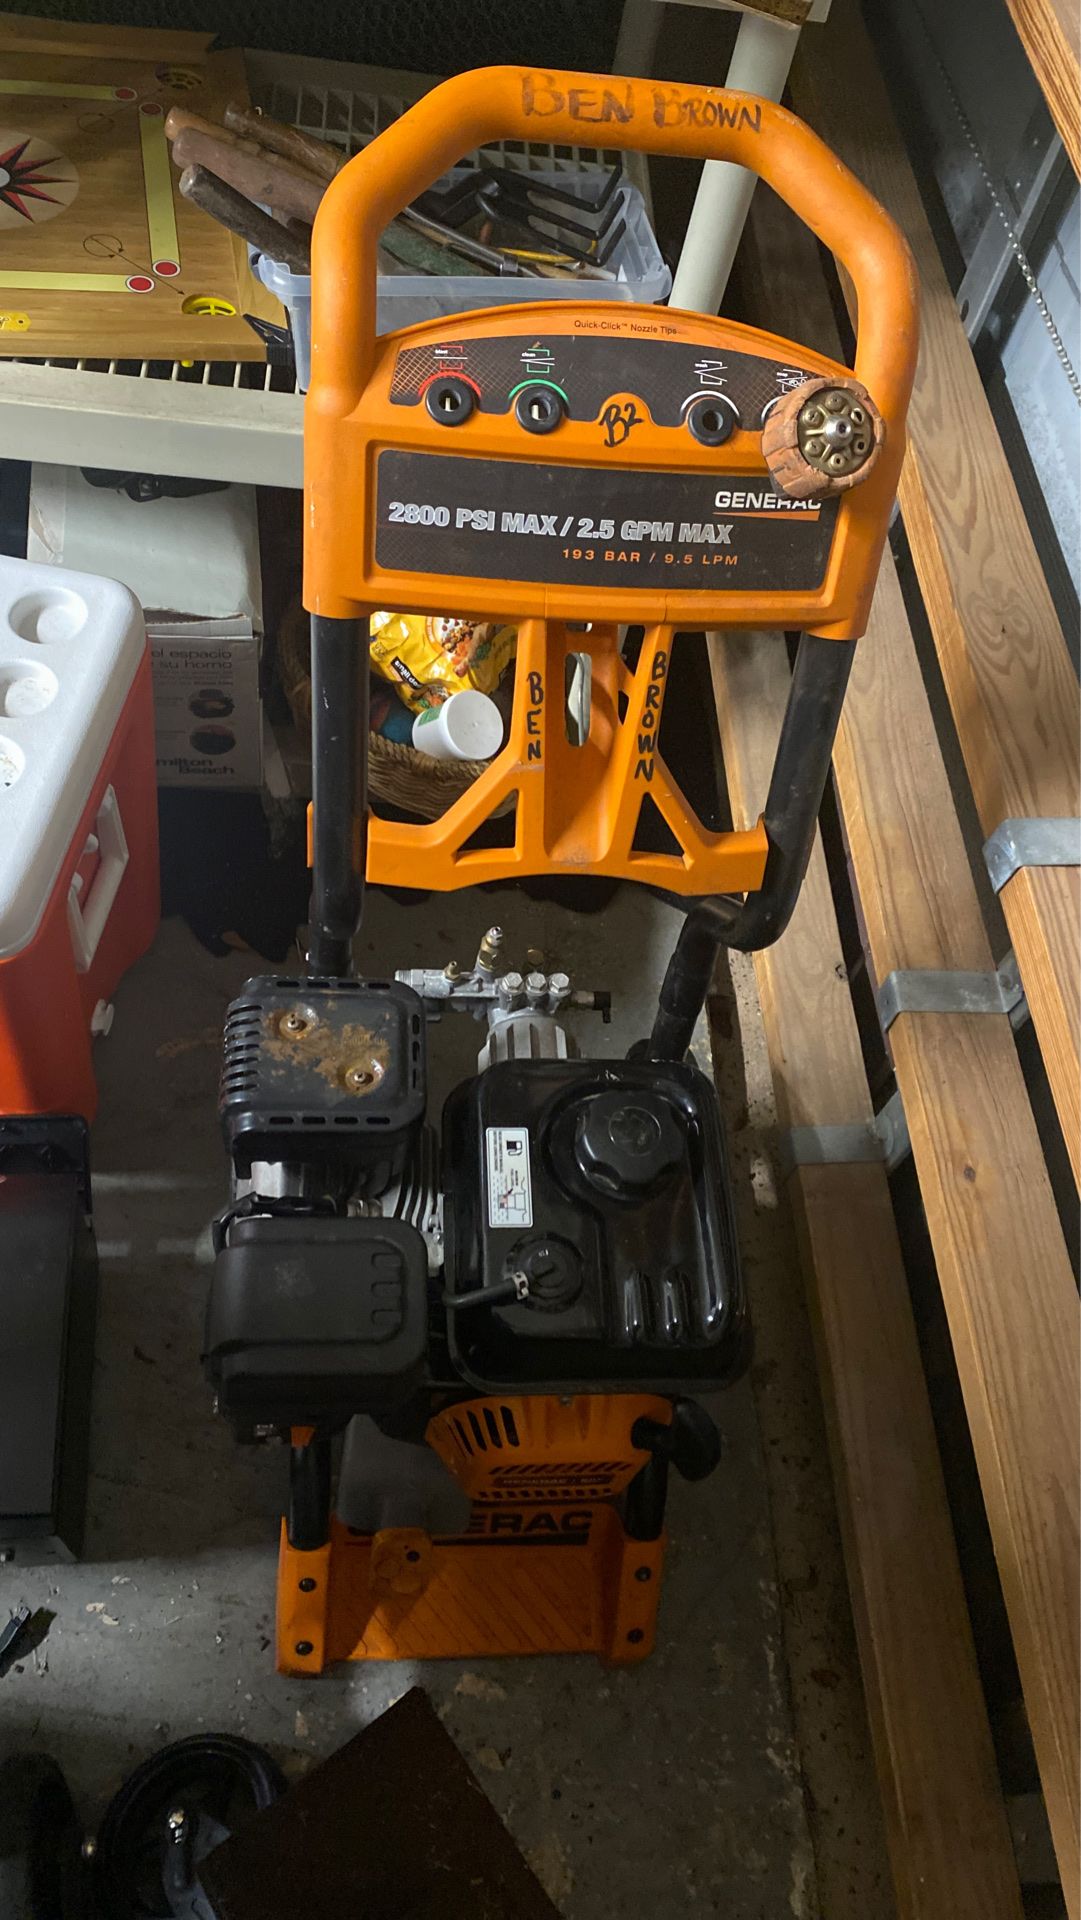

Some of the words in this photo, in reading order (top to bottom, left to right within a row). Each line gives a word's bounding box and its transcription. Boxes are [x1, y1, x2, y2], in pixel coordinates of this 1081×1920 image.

[522, 73, 634, 123] BEN
[651, 86, 762, 133] BROWN
[630, 324, 658, 333] Nozzle
[660, 326, 677, 335] Tips
[388, 501, 451, 527] 2800
[456, 508, 496, 531] PSI
[501, 512, 558, 537] MAX
[577, 518, 616, 540] 2.5
[620, 520, 675, 543] GPM
[678, 523, 733, 545] MAX
[562, 548, 595, 561] 193
[604, 550, 641, 563] BAR
[664, 553, 693, 565] 9.5
[702, 554, 739, 566] LPM
[169, 648, 232, 661] espacio
[527, 671, 545, 760] BEN
[634, 650, 667, 782] BROWN
[156, 757, 213, 767] milton
[465, 1510, 593, 1534] ERAC
